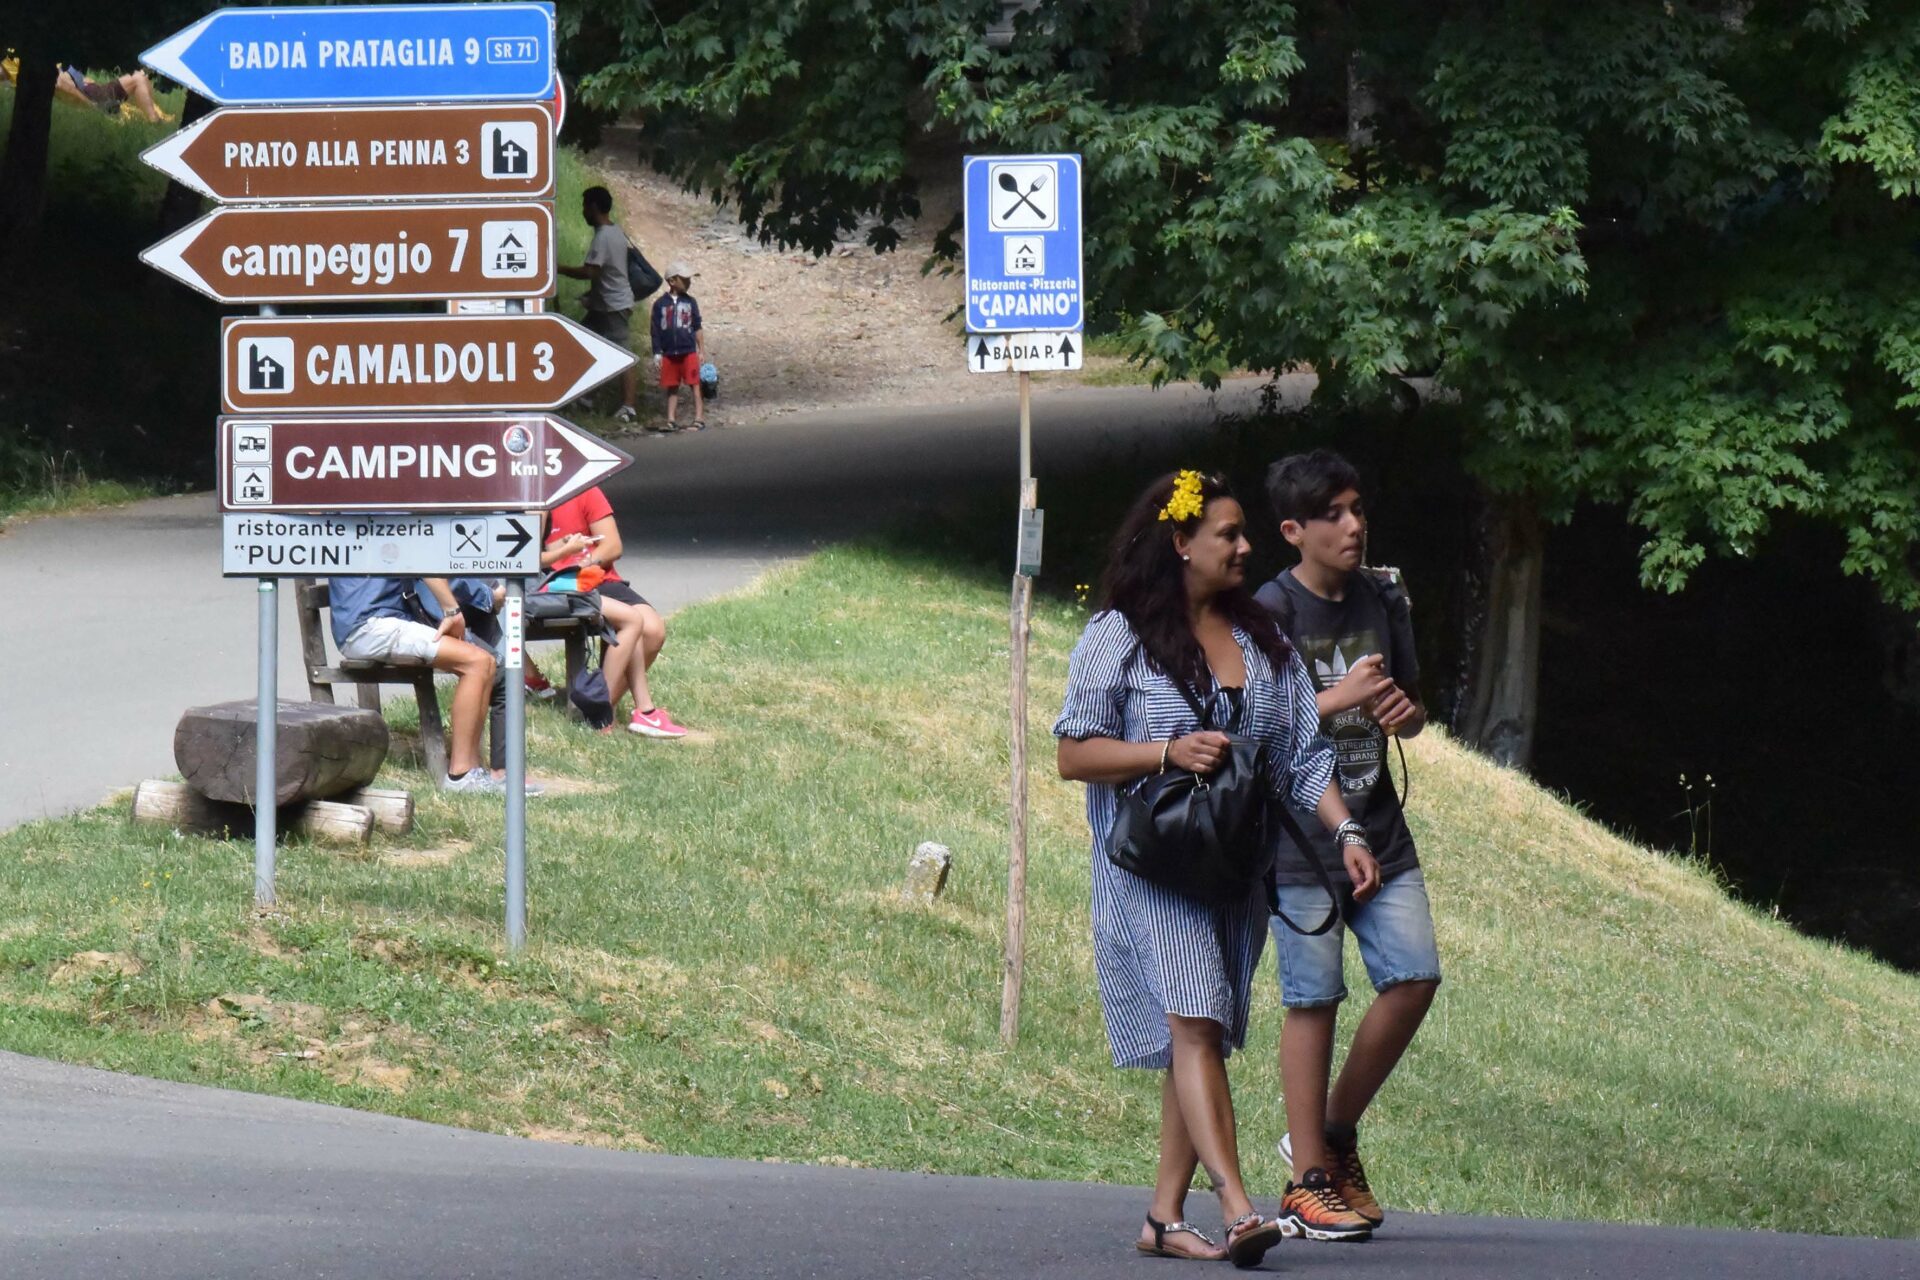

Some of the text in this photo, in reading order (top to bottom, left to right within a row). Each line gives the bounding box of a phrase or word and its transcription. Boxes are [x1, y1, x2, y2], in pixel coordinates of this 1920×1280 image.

[229, 37, 532, 70] BADIA PRATAGLIA 9 SR 71
[224, 139, 470, 168] PRATO ALLA PENNA 3
[221, 228, 469, 286] campeggio 7
[971, 278, 1026, 291] Ristorante
[972, 292, 1077, 316] "CAPANNO"
[306, 341, 555, 385] CAMALDOLI 3
[993, 345, 1054, 360] BADIA P.
[285, 443, 563, 479] CAMPING Km 3
[238, 519, 434, 539] ristorante pizzeria
[449, 560, 523, 569] loc. PUCINI 4
[1349, 751, 1379, 762] BRAND
